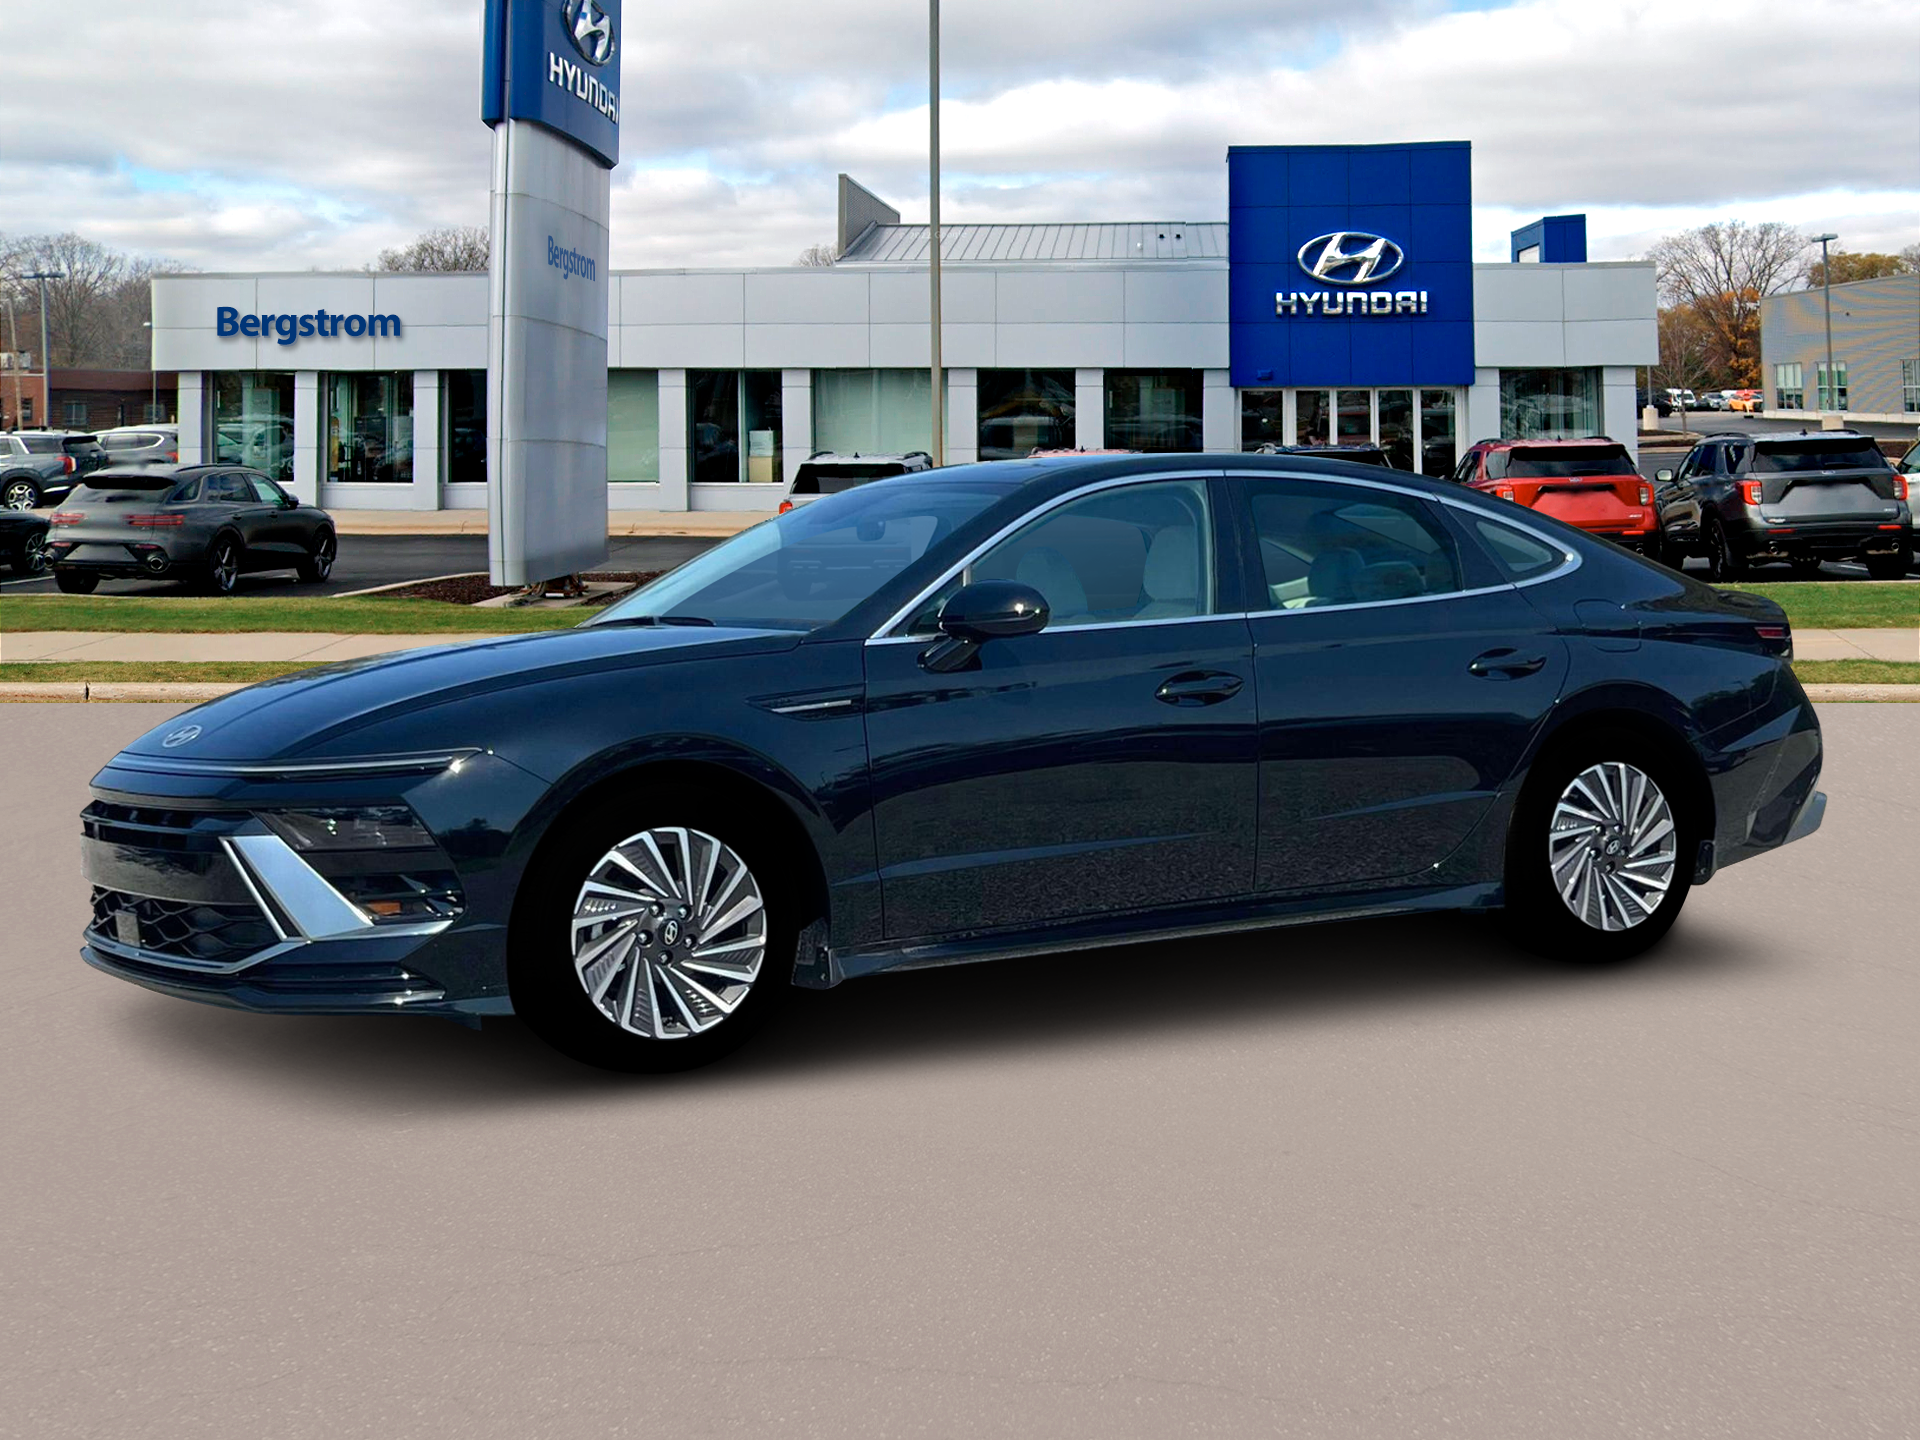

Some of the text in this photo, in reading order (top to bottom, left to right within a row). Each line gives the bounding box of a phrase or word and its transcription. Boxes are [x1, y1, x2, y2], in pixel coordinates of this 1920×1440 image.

[548, 52, 619, 123] HYUNDAI
[547, 235, 595, 281] Bergstrom
[1275, 291, 1428, 315] HYUNDAI
[217, 306, 401, 345] Bergstrom
